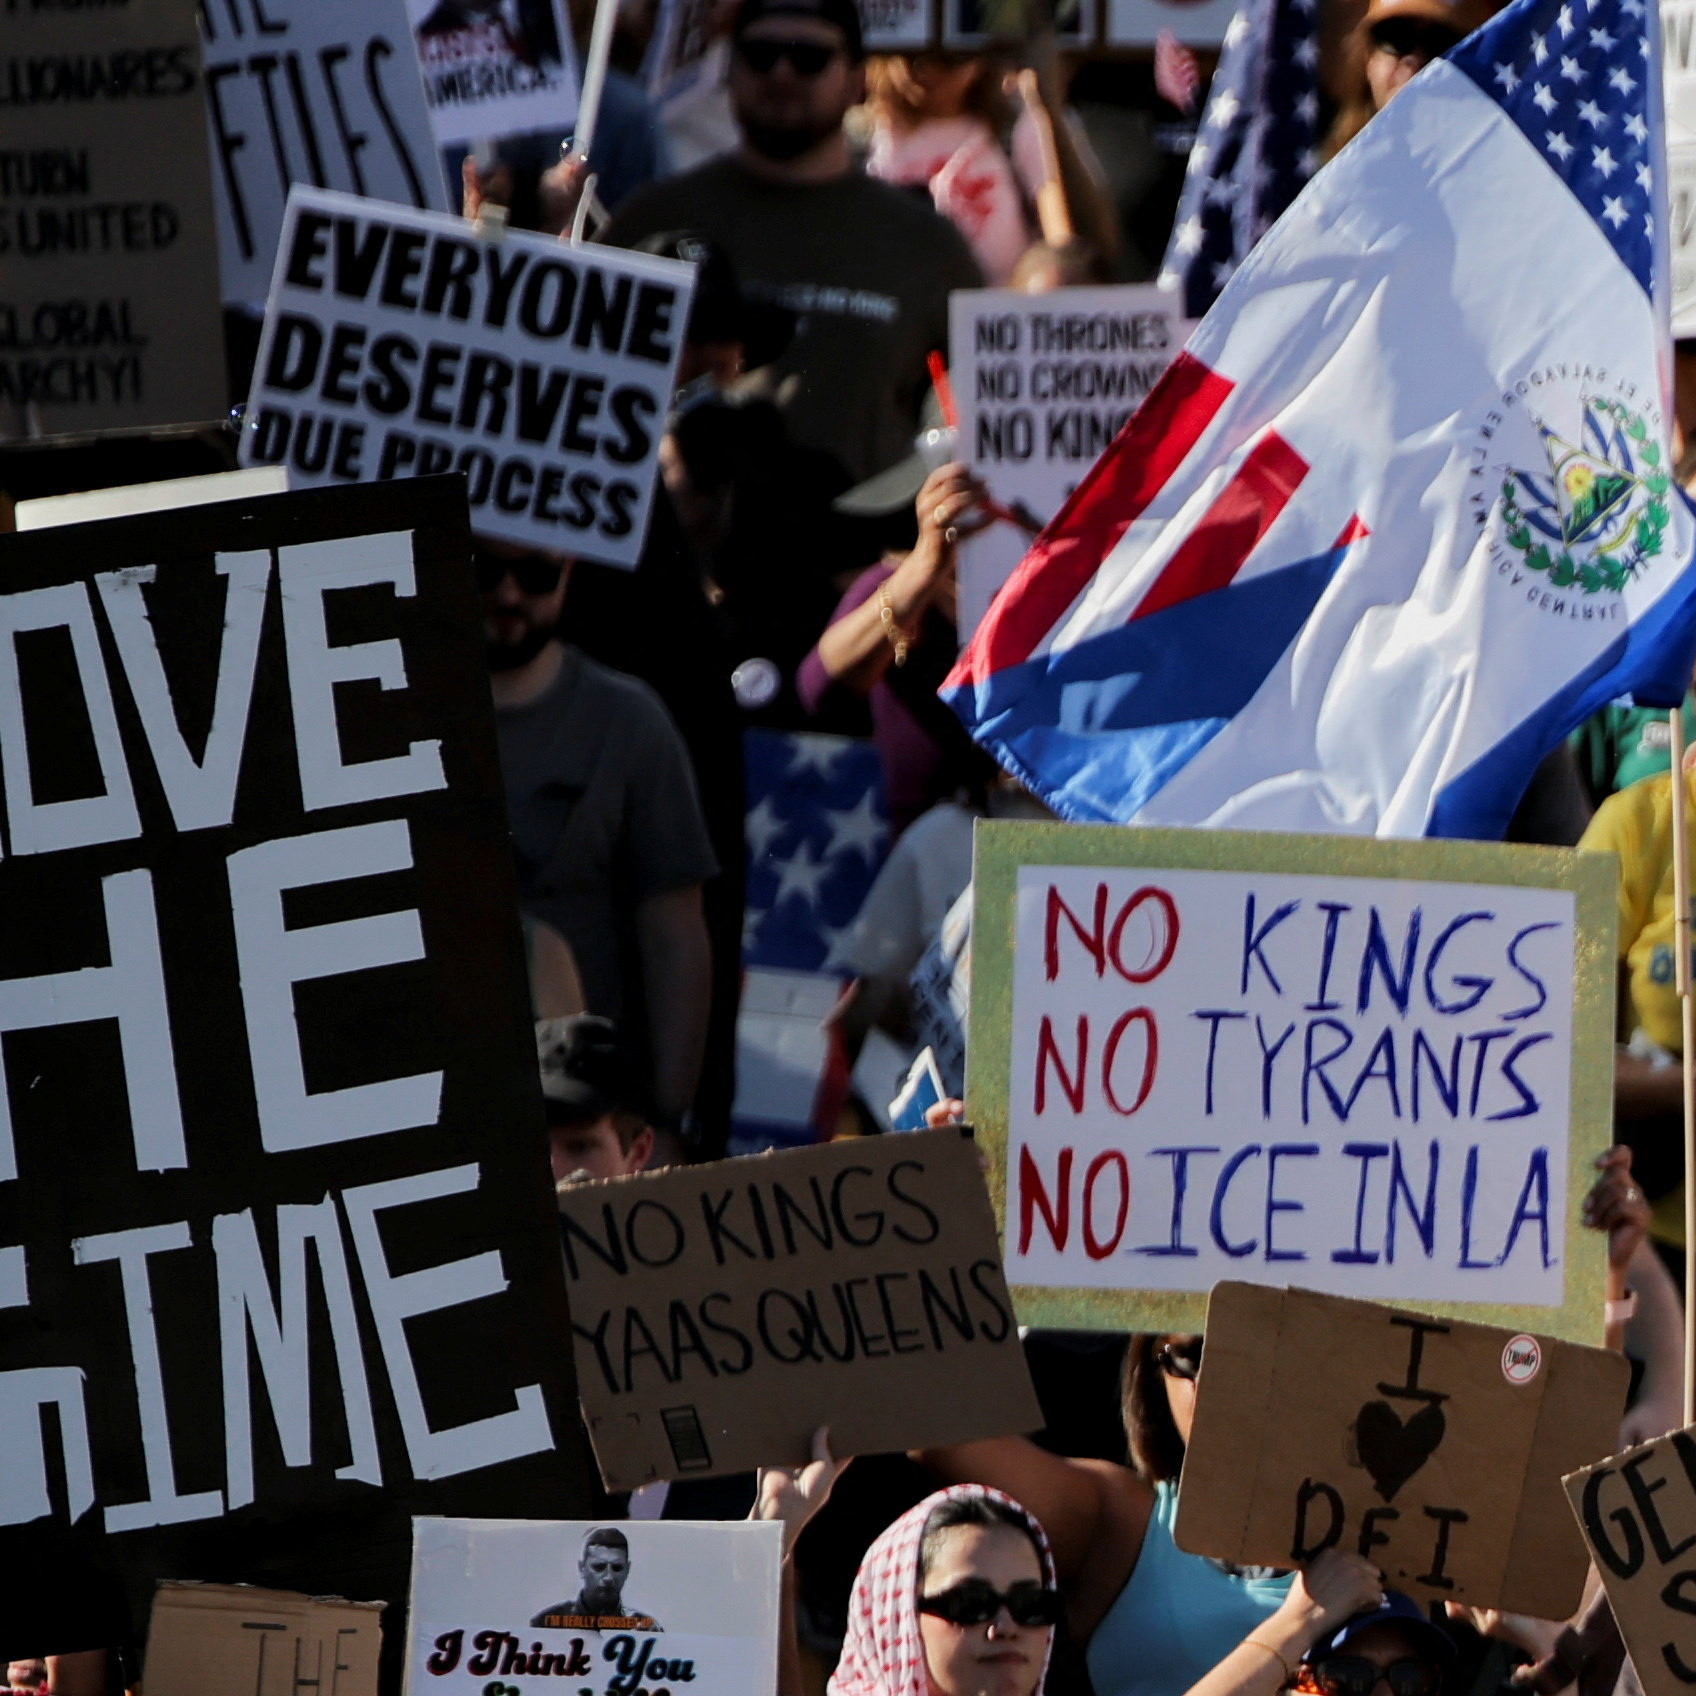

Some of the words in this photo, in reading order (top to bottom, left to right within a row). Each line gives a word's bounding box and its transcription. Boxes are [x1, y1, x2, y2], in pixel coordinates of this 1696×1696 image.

[286, 210, 678, 366] EVERYONE
[975, 313, 1020, 353] NO
[1029, 312, 1171, 353] THRONES
[263, 312, 661, 466] DESERVES
[974, 361, 1020, 402] NO
[975, 410, 1035, 463] NO
[250, 405, 370, 483] DUE
[375, 433, 641, 540] PROCESS
[1044, 881, 1181, 985] NO
[1240, 892, 1563, 1023] KINGS
[1033, 1005, 1159, 1118] NO
[1188, 1009, 1555, 1125] TYRANTS
[559, 1200, 685, 1282] NO
[701, 1158, 941, 1266] KINGS
[1016, 1142, 1131, 1262] NO
[1124, 1143, 1323, 1263] ICE
[1330, 1138, 1440, 1266] IN
[1456, 1144, 1560, 1272] LA
[571, 1292, 754, 1396] YAAS
[756, 1259, 1011, 1364] QUEENS
[1375, 1316, 1450, 1403] I
[426, 1628, 464, 1677] I
[465, 1629, 594, 1680] Think
